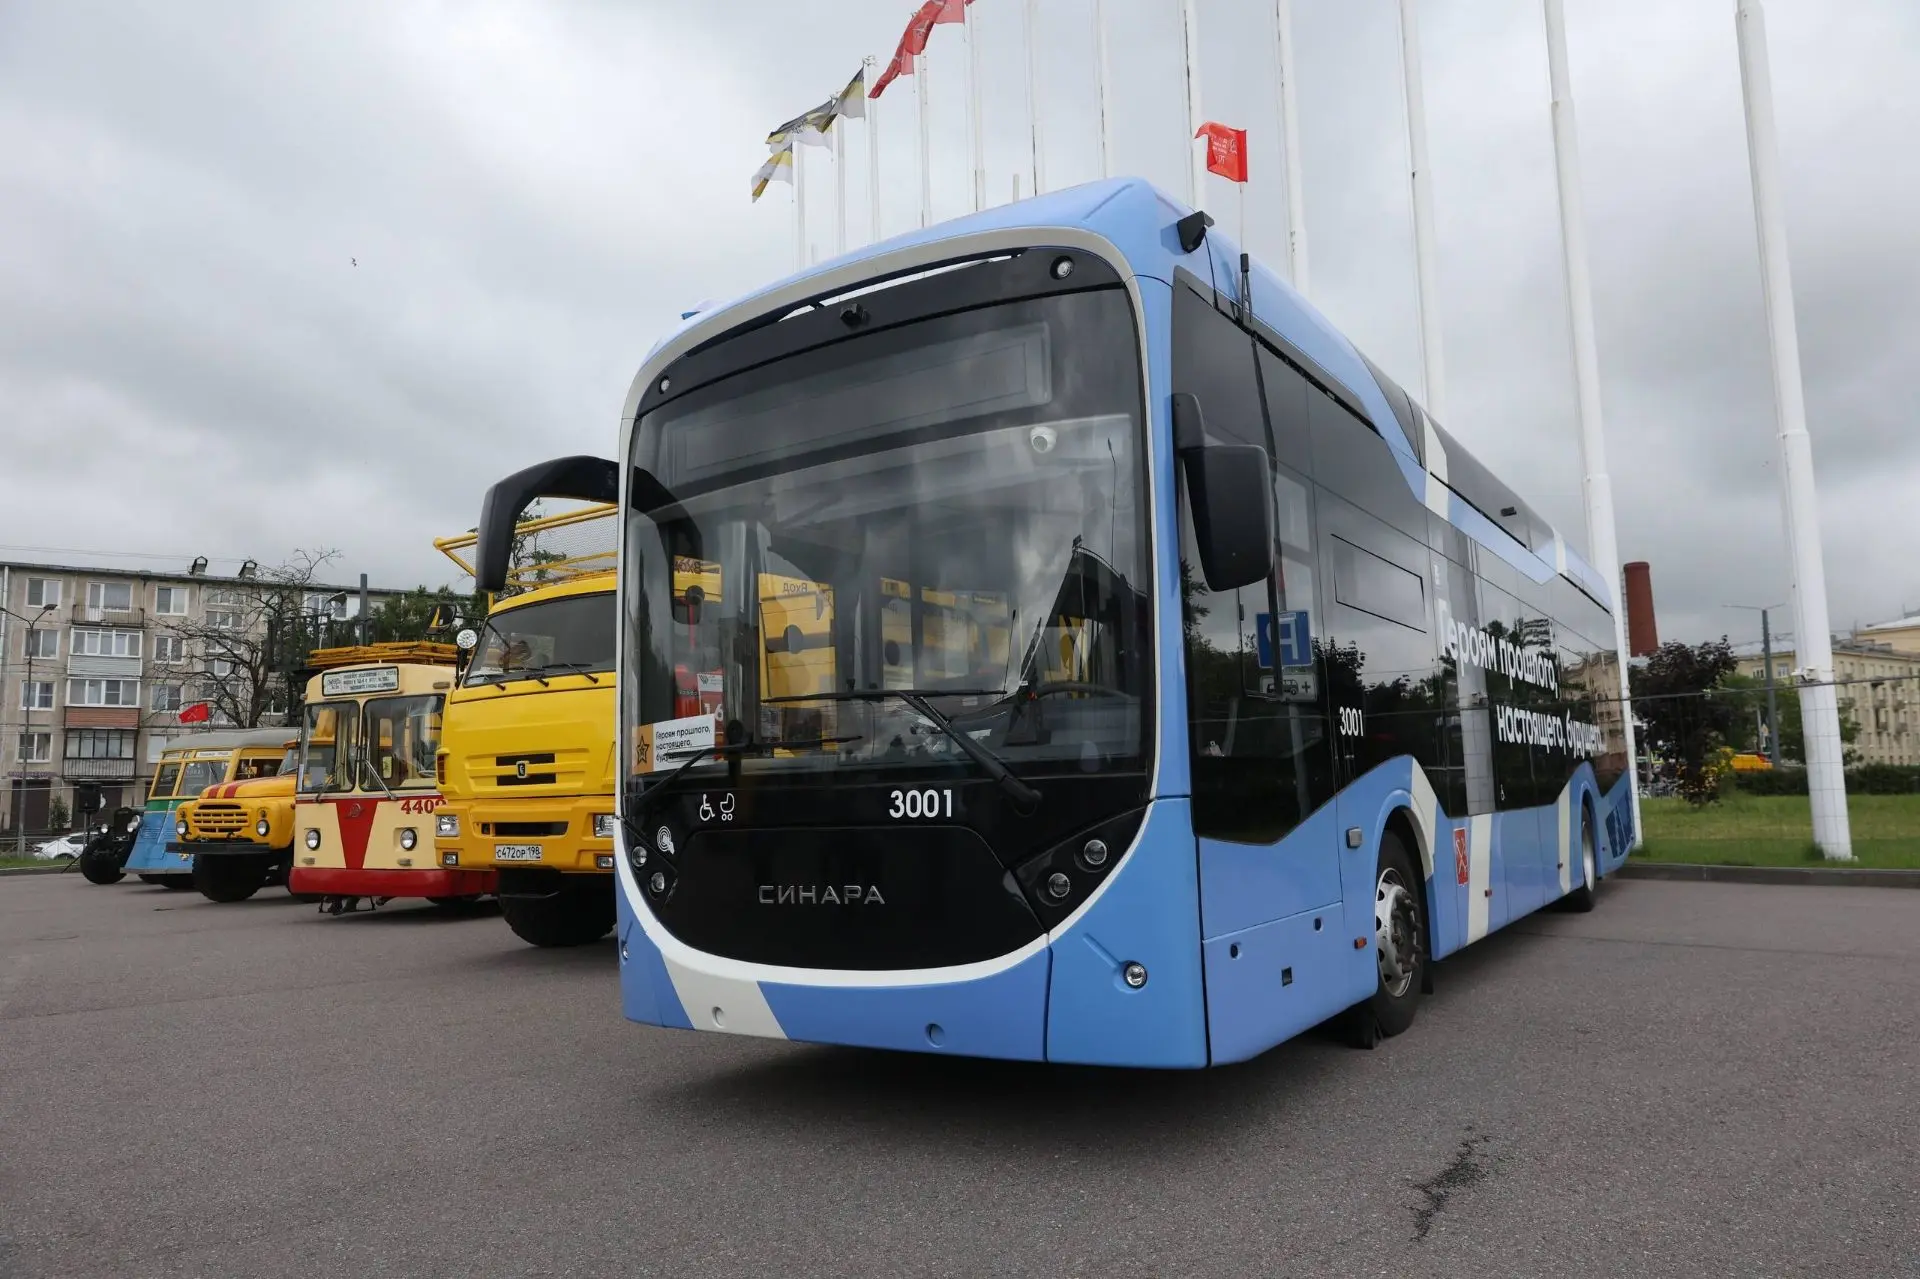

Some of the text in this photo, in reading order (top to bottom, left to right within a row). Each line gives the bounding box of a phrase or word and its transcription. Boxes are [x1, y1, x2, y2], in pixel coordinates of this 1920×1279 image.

[1437, 598, 1498, 678] Героям
[1339, 706, 1364, 737] 3001
[889, 789, 952, 818] 3001
[759, 885, 885, 905] СИНАРА
